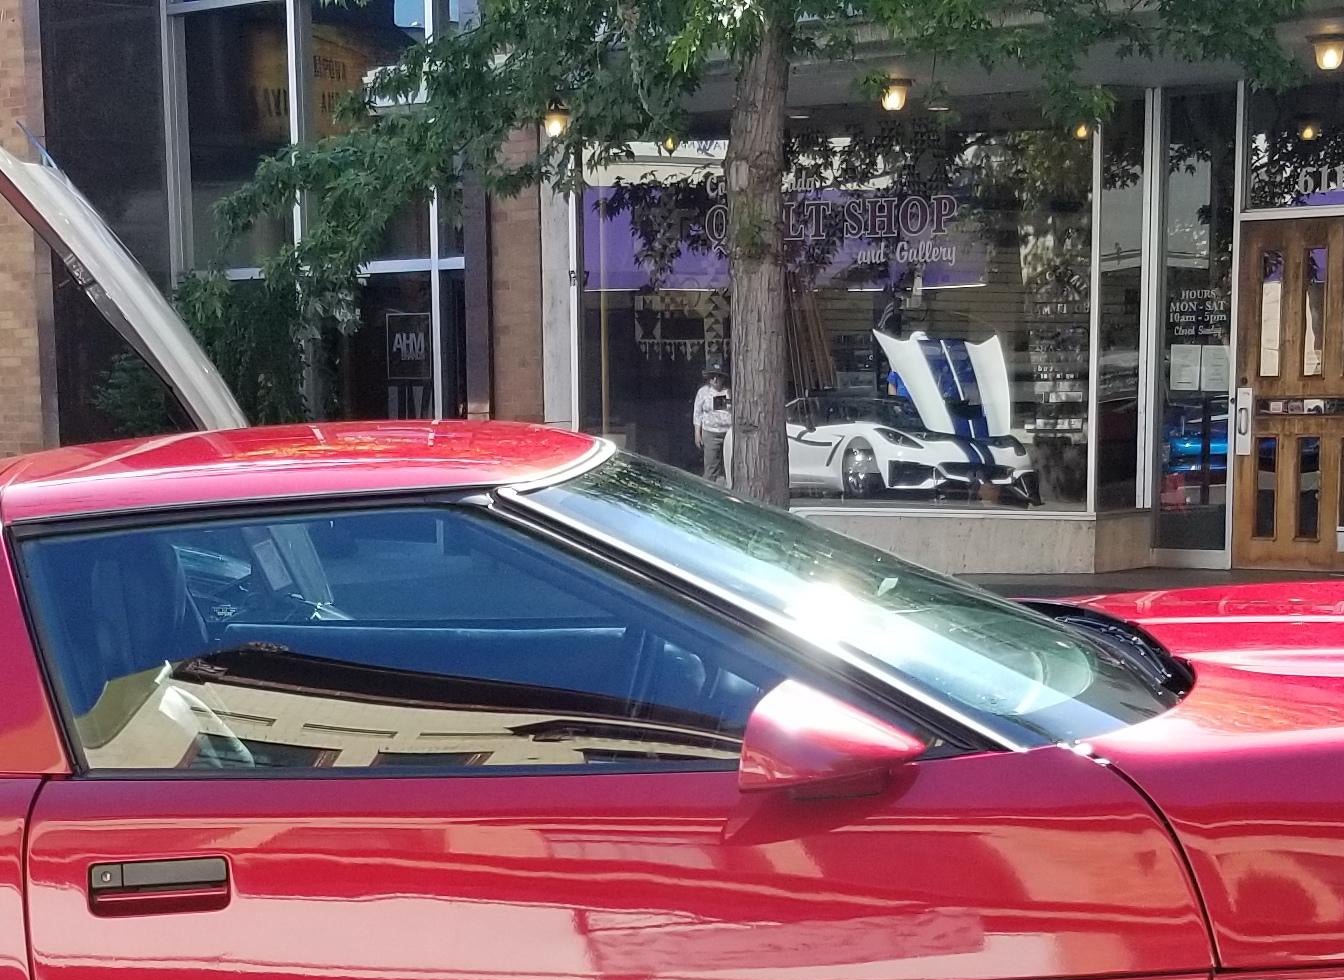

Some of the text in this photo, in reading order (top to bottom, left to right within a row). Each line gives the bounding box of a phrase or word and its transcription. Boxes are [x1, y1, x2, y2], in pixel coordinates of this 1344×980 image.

[1297, 164, 1344, 194] 611
[705, 194, 958, 255] QLT SHOP
[857, 241, 956, 266] and Gallery
[1181, 289, 1217, 300] HOURS
[1169, 302, 1198, 313] MON
[1205, 300, 1227, 312] SAT
[1169, 312, 1196, 322] 10am
[1204, 311, 1227, 325] 5pm
